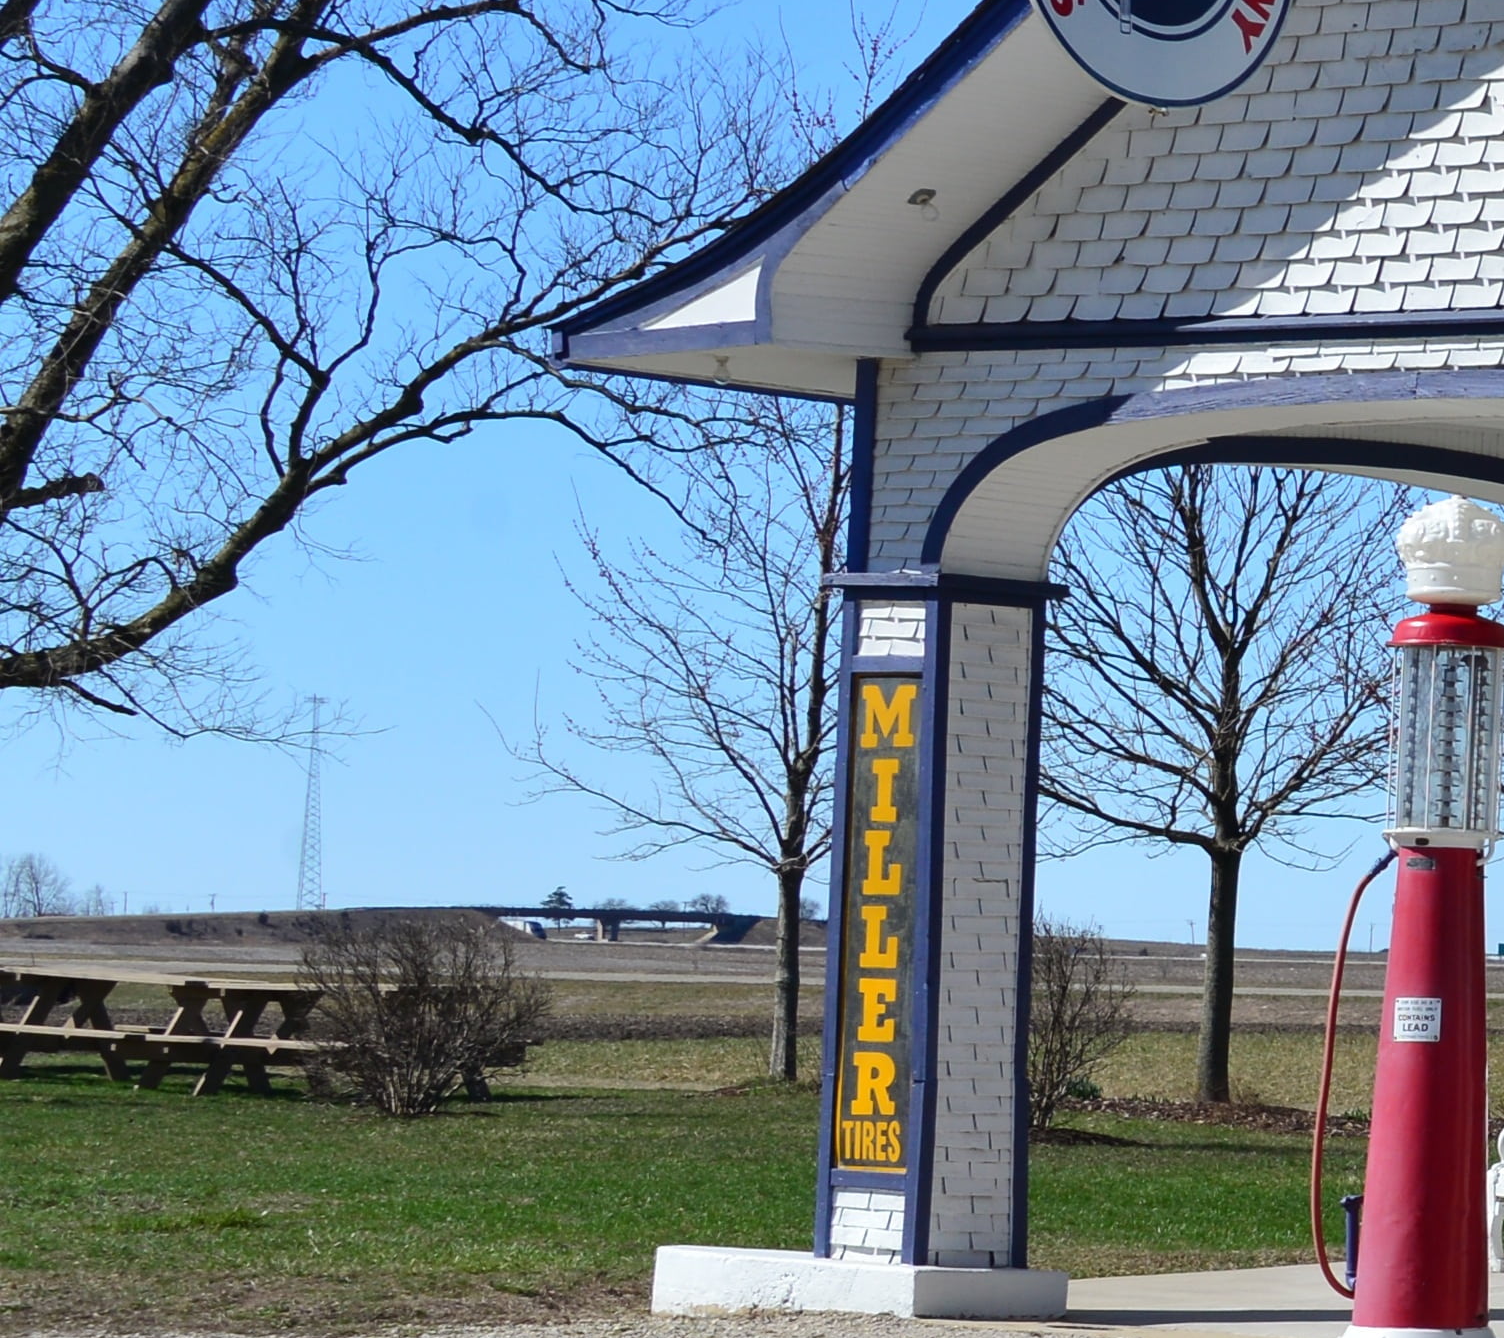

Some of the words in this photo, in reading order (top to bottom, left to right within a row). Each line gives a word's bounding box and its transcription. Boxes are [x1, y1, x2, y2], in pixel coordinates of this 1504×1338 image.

[850, 684, 918, 1116] MILLER
[1398, 1014, 1436, 1022] CONTAINS
[1402, 1023, 1429, 1032] LEAD
[842, 1120, 901, 1163] TIRES
